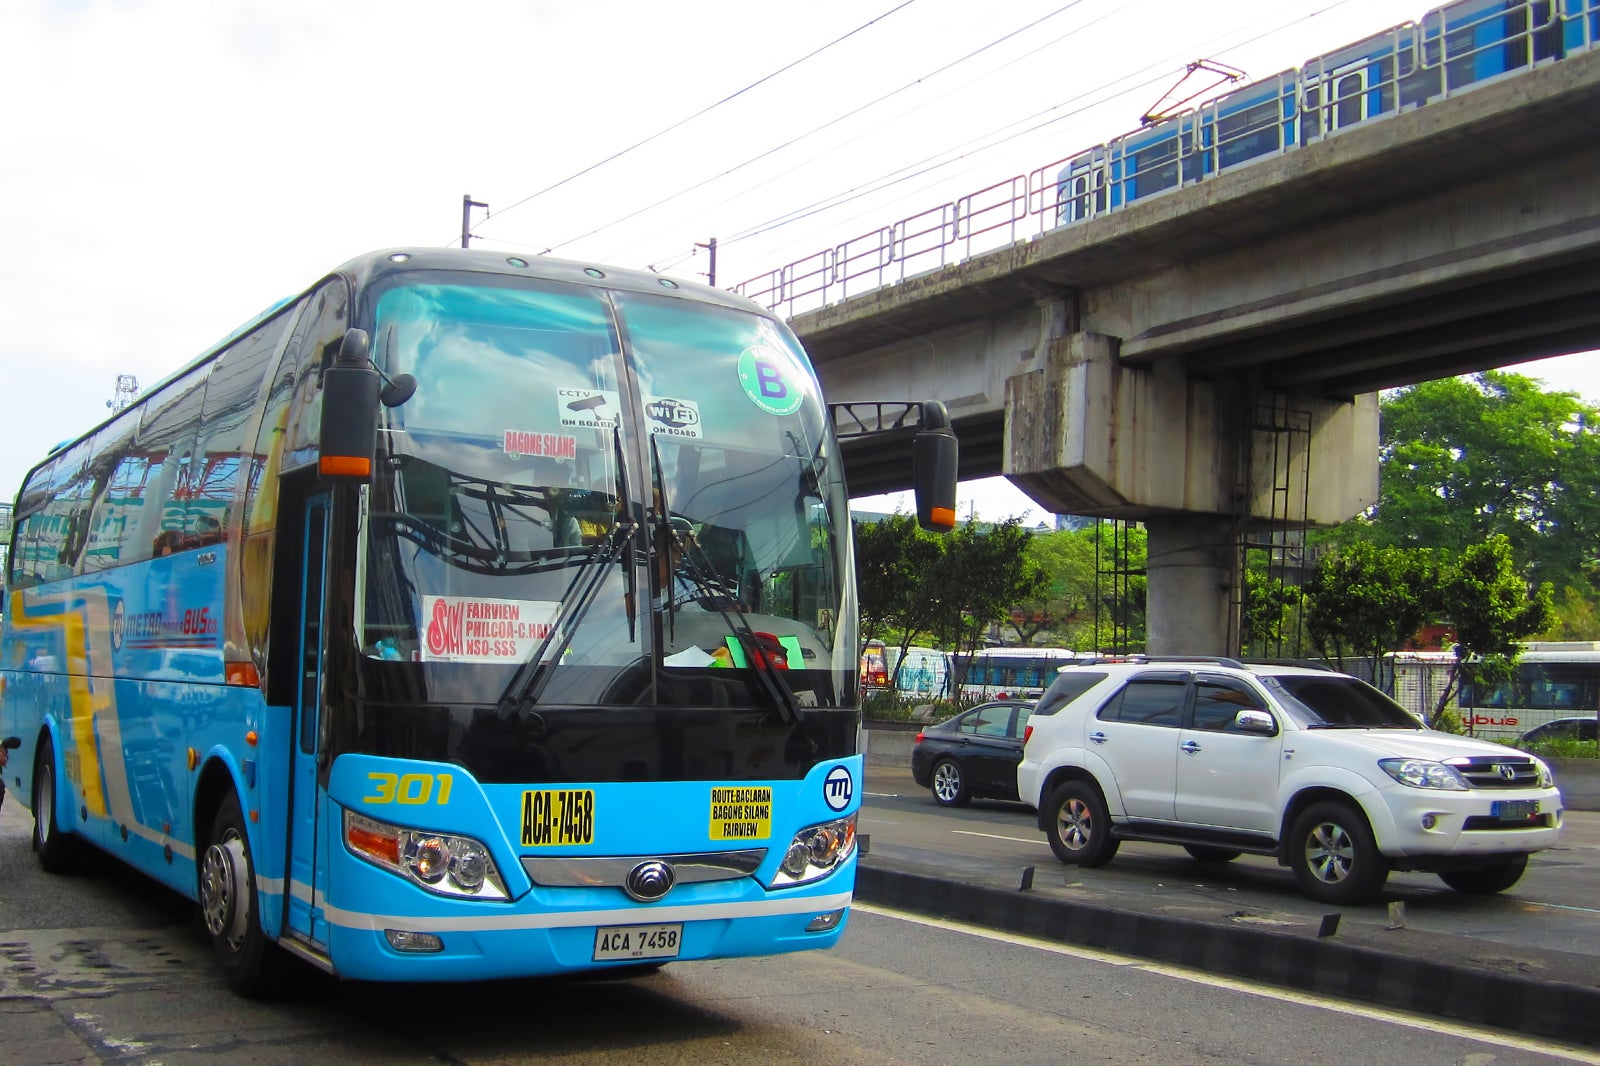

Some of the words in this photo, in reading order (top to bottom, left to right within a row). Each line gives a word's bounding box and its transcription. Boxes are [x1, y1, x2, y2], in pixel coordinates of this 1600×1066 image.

[754, 361, 787, 398] B
[559, 389, 590, 398] CCTV
[562, 419, 576, 427] ON
[579, 420, 615, 429] BOARD
[653, 426, 666, 434] ON
[668, 428, 697, 438] BOARD
[505, 431, 542, 455] BAGONG
[543, 434, 575, 458] SILANG
[183, 606, 209, 635] BUS
[466, 602, 520, 621] FAIRVIEW
[428, 598, 465, 656] SM
[466, 639, 517, 656] NSO-SSS
[1458, 711, 1519, 728] ybus
[362, 772, 453, 805] 301
[521, 790, 593, 845] ACA-7458
[712, 805, 743, 820] BAGONG
[744, 805, 769, 820] SILANG
[723, 822, 758, 837] FAIRVIEW
[600, 932, 630, 952] ACA
[639, 930, 677, 950] 7458
